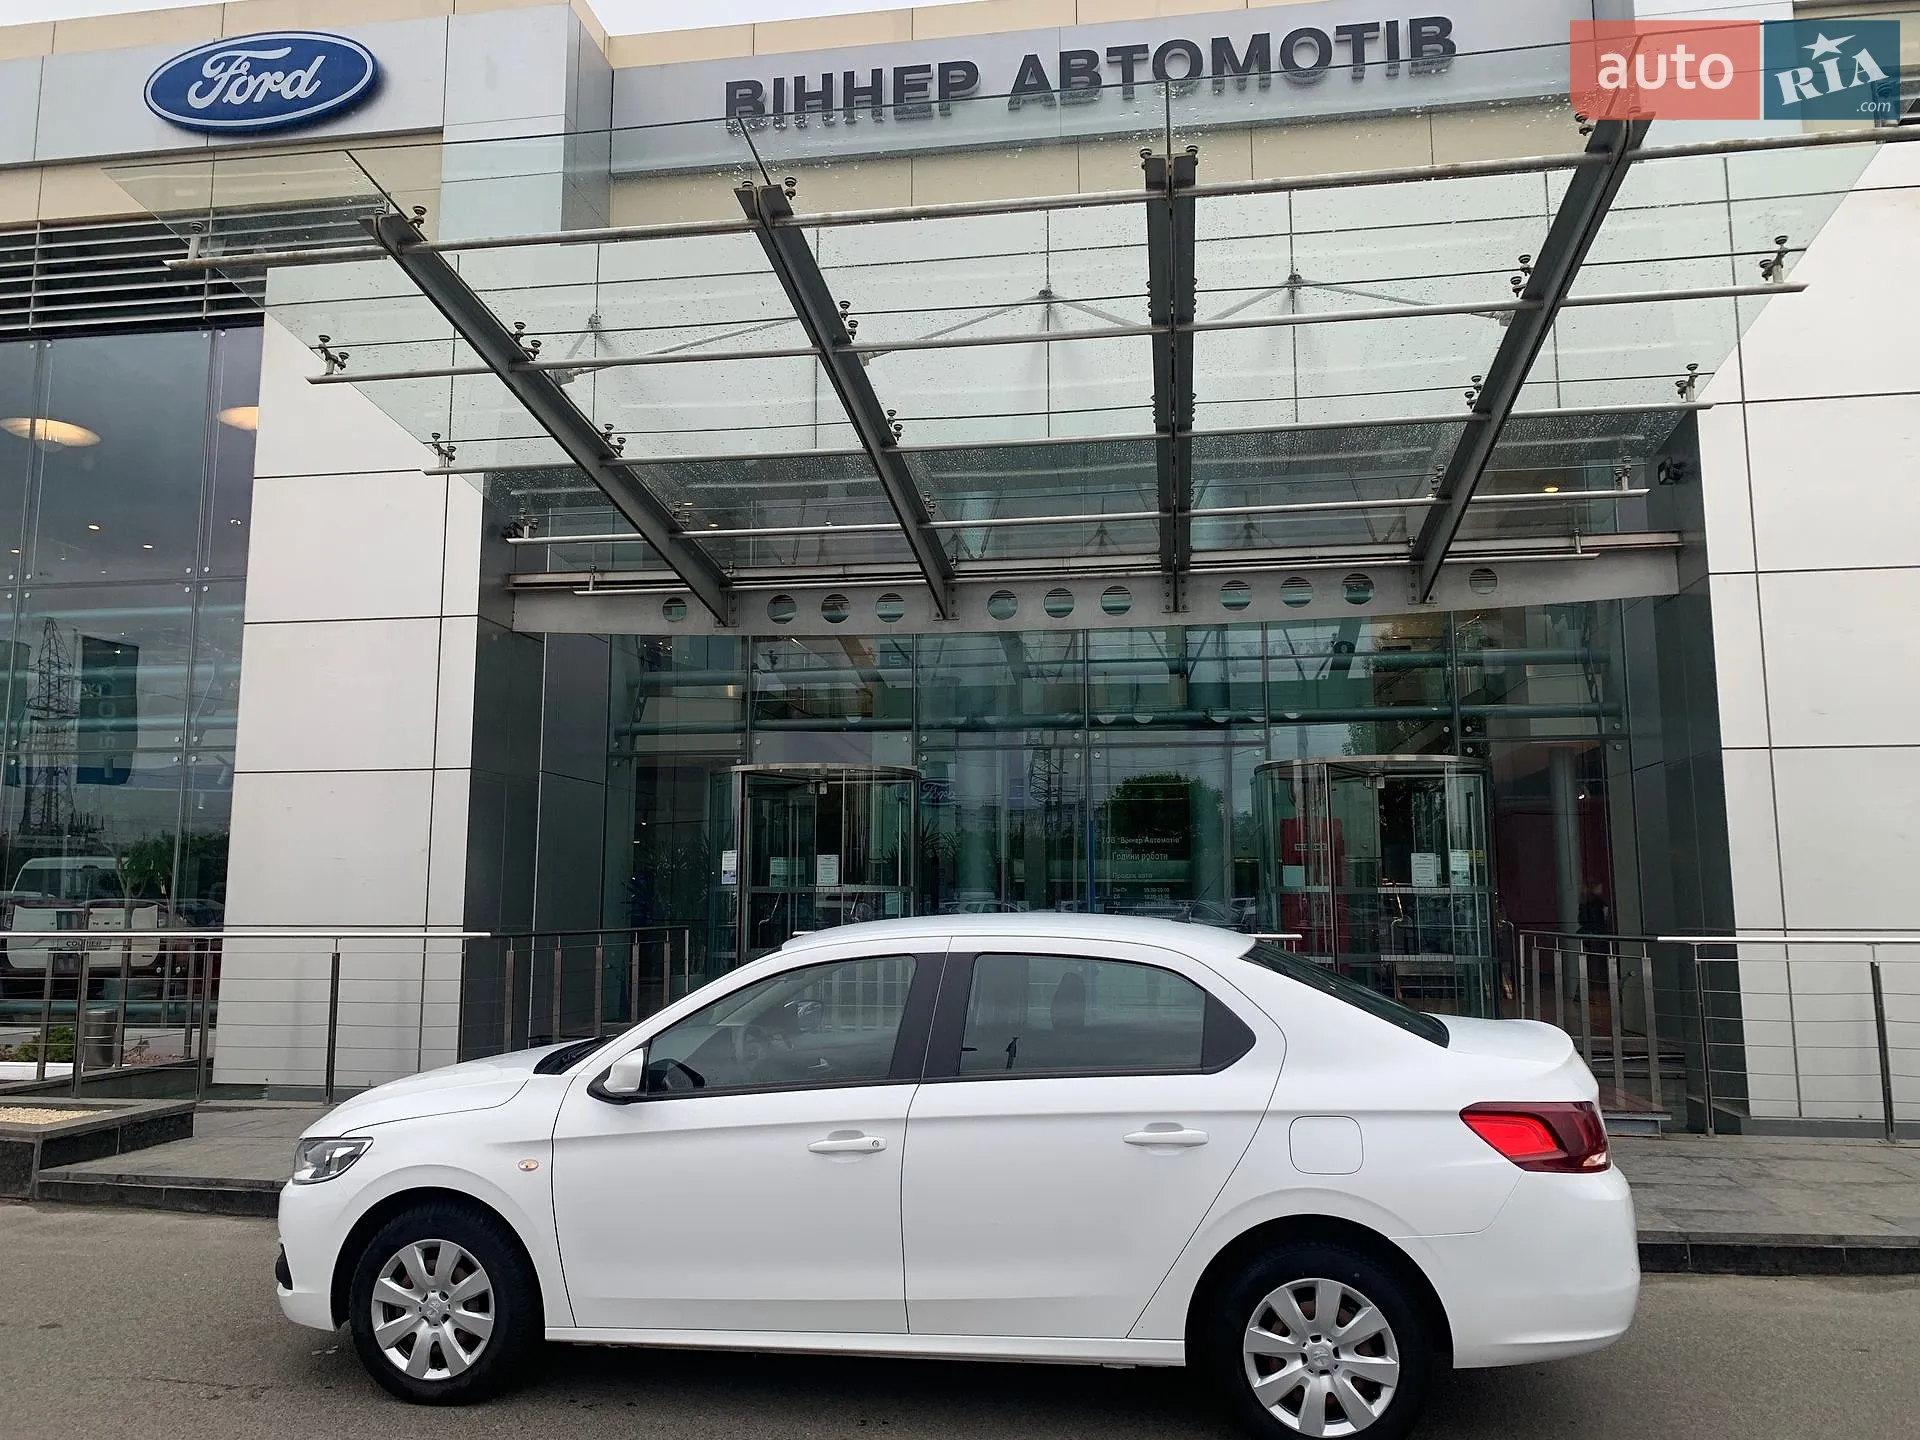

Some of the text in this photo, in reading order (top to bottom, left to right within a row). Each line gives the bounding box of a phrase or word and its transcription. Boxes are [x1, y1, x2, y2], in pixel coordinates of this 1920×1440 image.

[187, 46, 326, 109] Ford
[725, 15, 1457, 134] ВІННЕР АВТОМОТІВ
[1112, 851, 1168, 862] Години роботи
